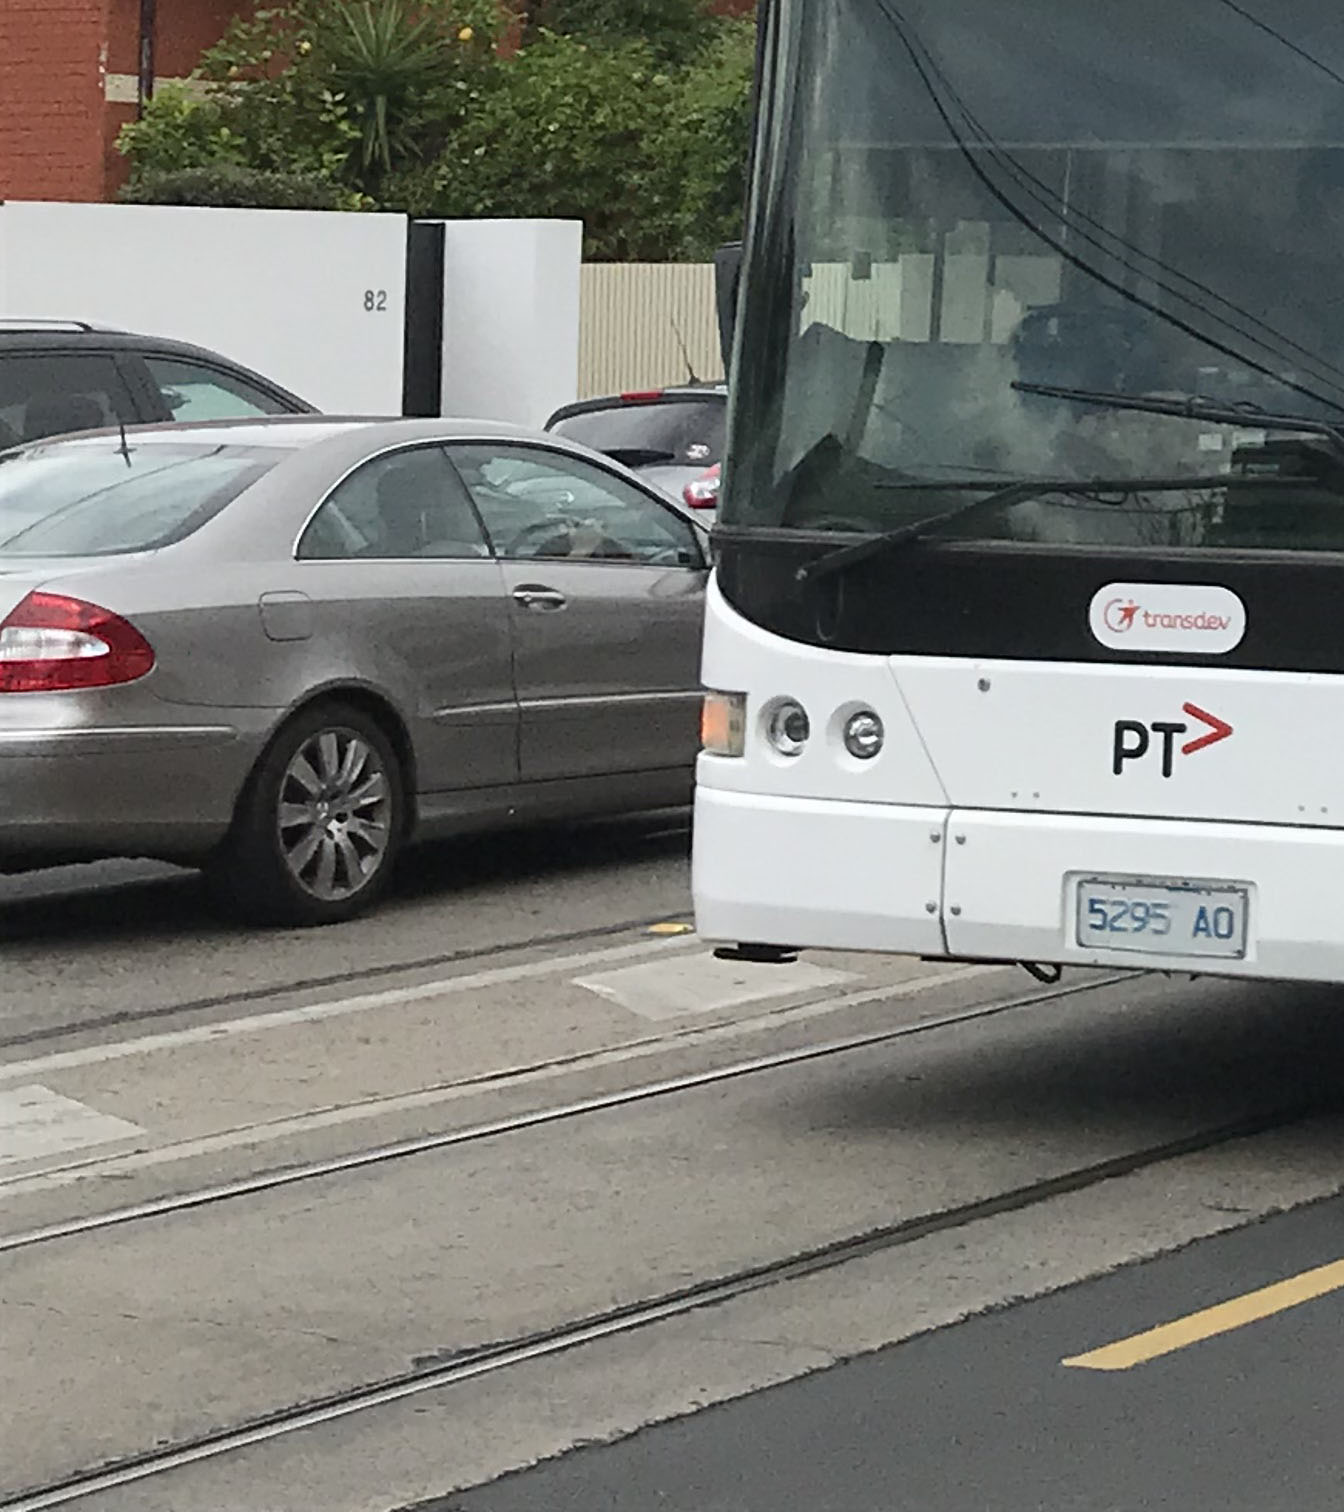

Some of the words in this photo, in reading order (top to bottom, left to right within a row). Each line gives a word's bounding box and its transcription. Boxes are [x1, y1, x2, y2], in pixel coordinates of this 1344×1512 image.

[364, 289, 387, 312] 82
[1142, 608, 1232, 631] transdev
[1113, 719, 1188, 779] PT
[1087, 897, 1172, 936] 5295
